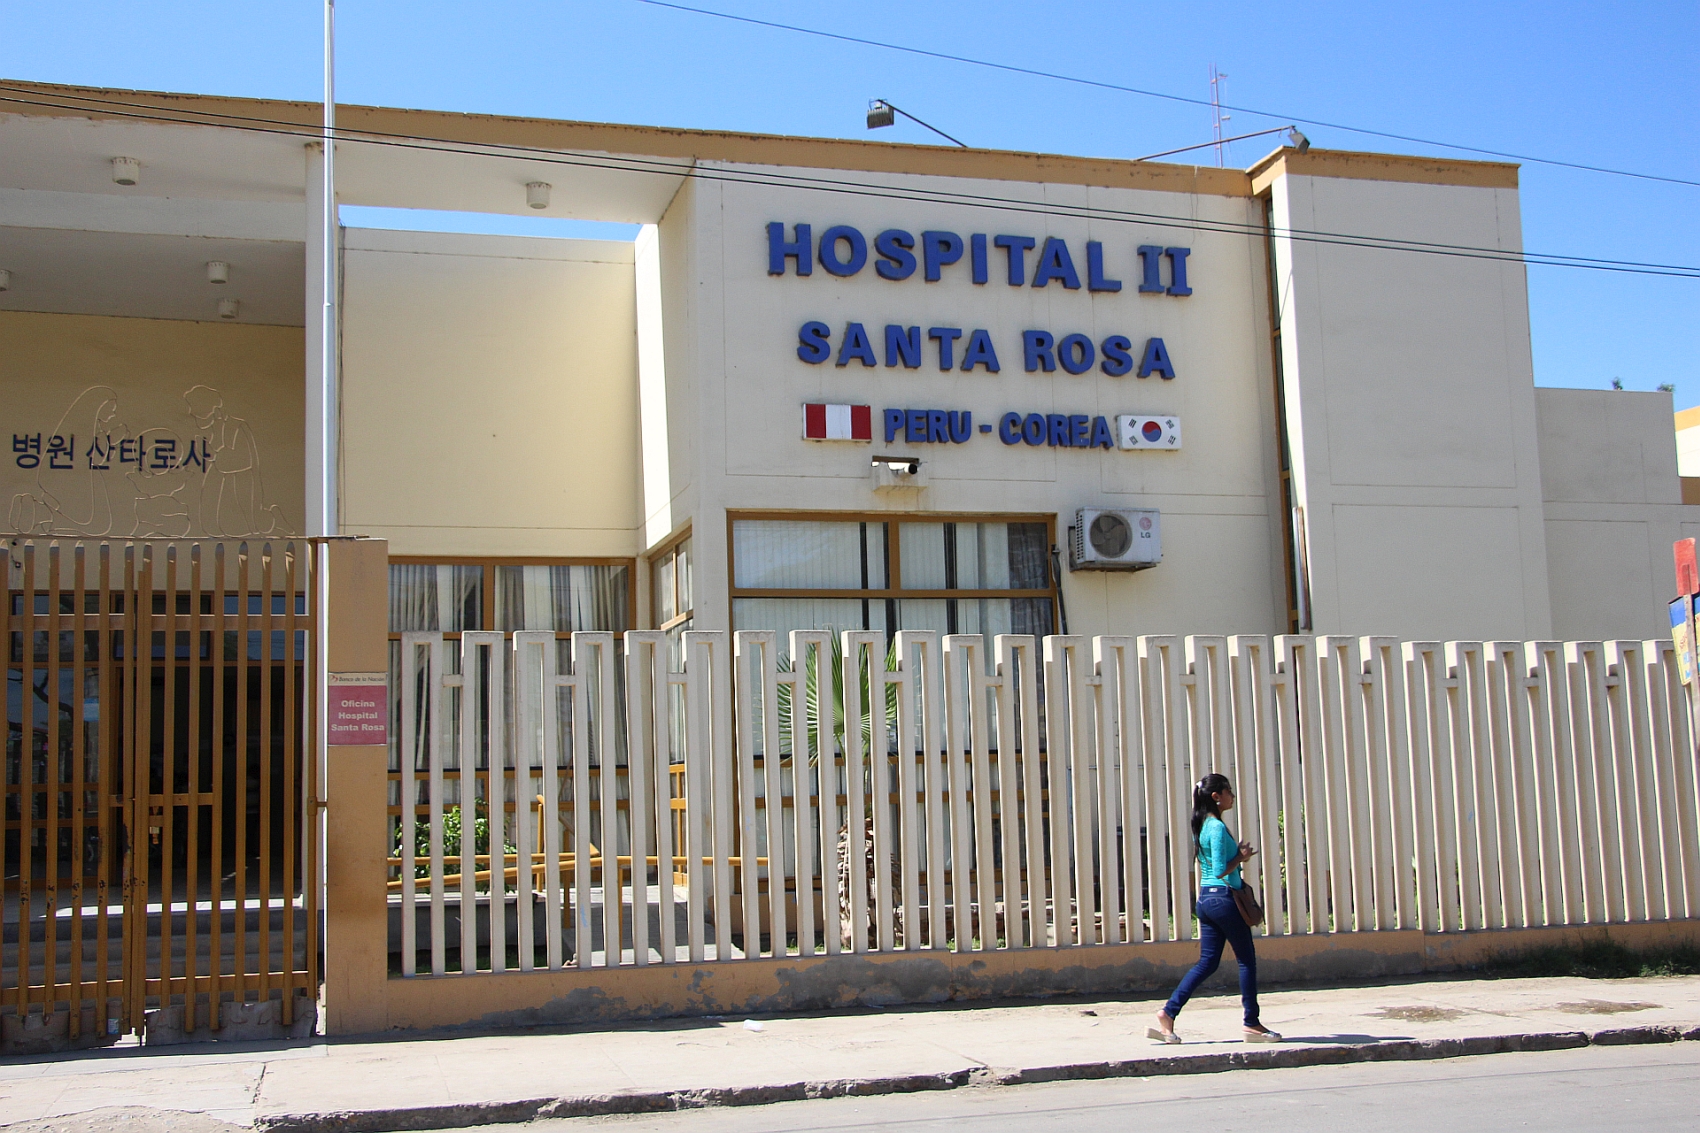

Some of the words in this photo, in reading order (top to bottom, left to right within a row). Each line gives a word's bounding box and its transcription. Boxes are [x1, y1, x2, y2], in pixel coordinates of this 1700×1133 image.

[766, 222, 1122, 292] HOSPITAL
[1137, 245, 1193, 296] II
[797, 321, 1000, 373] SANTA
[1022, 329, 1176, 380] ROSA
[884, 408, 972, 444] PERU
[1000, 411, 1115, 449] COREA
[12, 432, 75, 470] 병원
[85, 435, 211, 473] 산타로사
[1141, 531, 1151, 539] LG
[338, 712, 378, 720] Hospital
[341, 700, 376, 708] Oficina
[331, 723, 359, 731] Santa
[361, 723, 385, 731] Rosa
